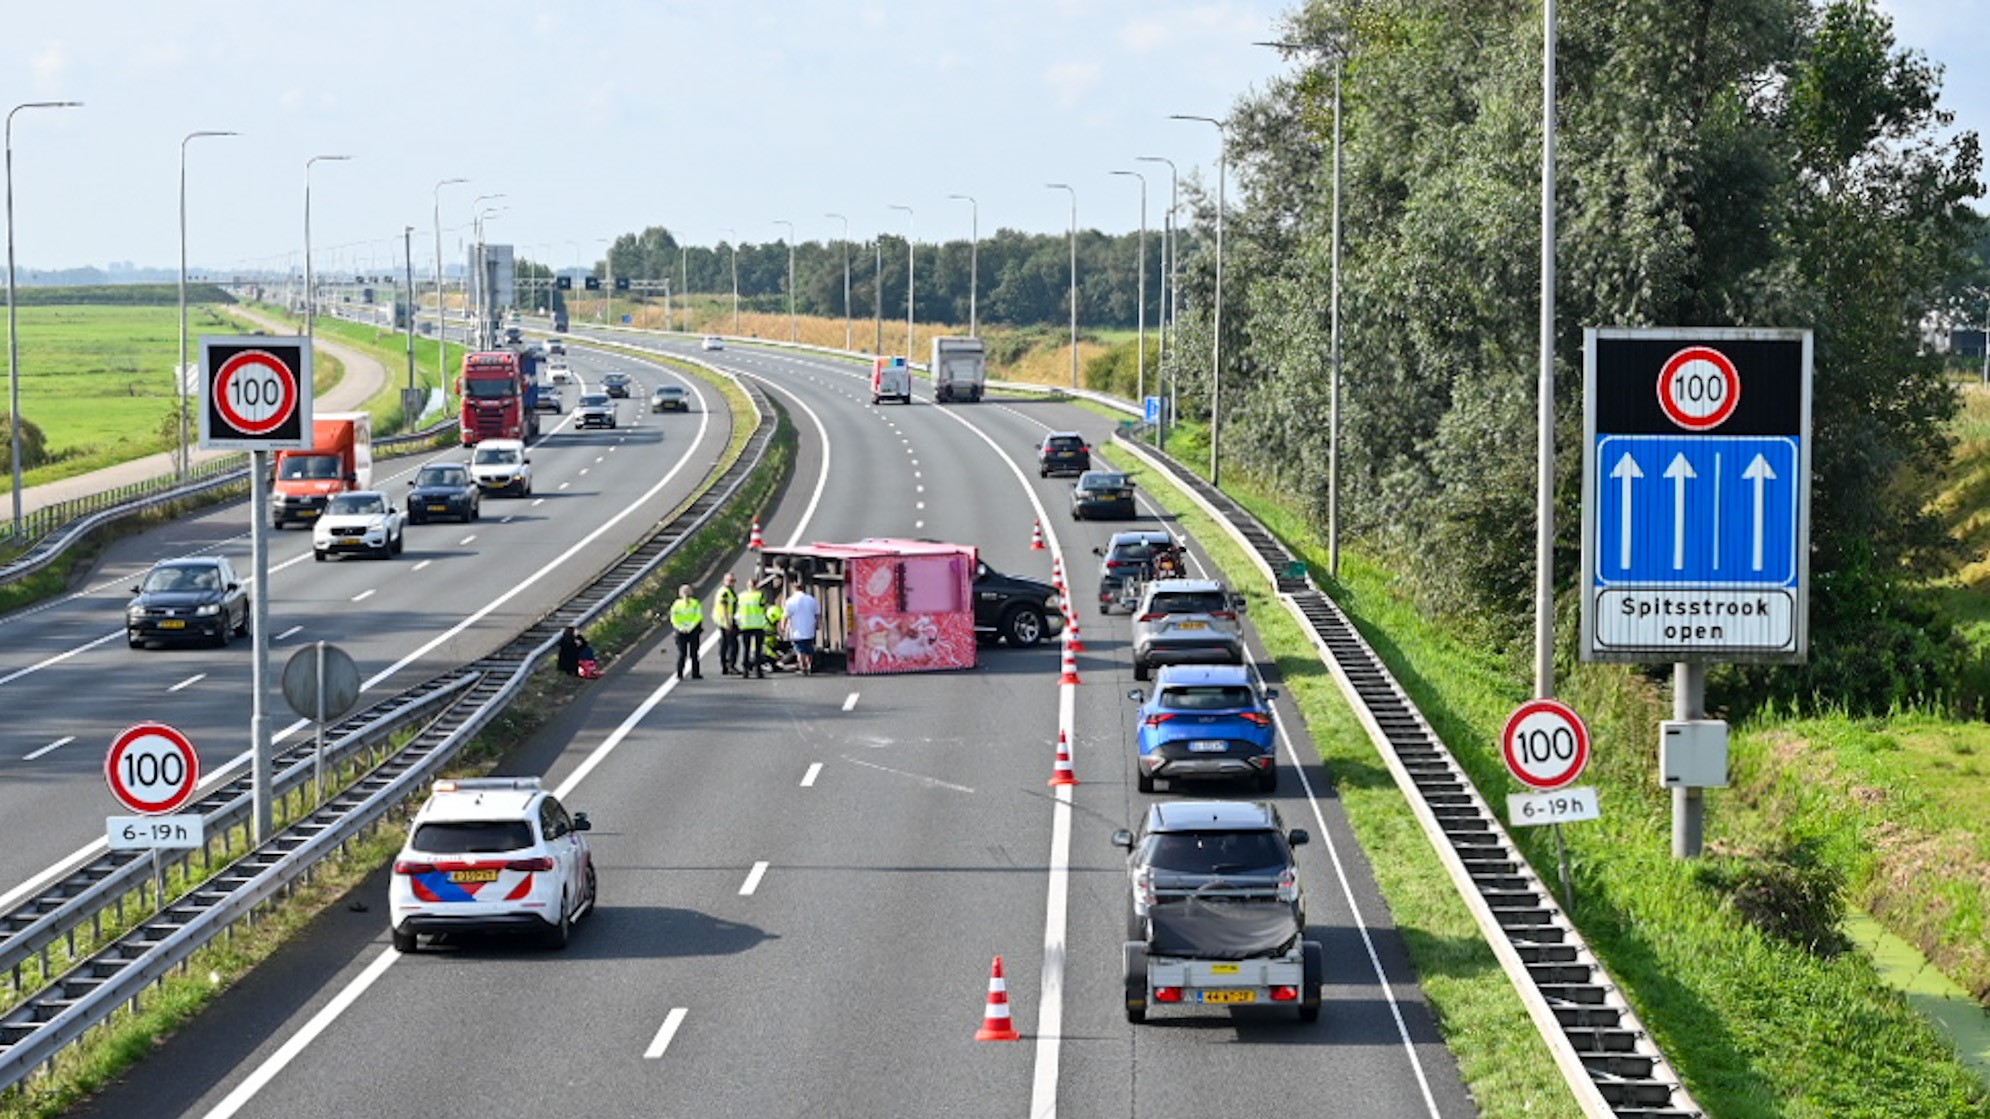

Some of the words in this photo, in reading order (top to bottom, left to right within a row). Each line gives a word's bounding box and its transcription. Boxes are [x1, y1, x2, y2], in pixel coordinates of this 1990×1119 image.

[231, 378, 279, 406] 100
[1675, 374, 1722, 402] 100
[1621, 597, 1769, 618] Spitsstrook
[1664, 625, 1724, 642] open
[1517, 727, 1574, 764] 100
[124, 753, 183, 787] 100
